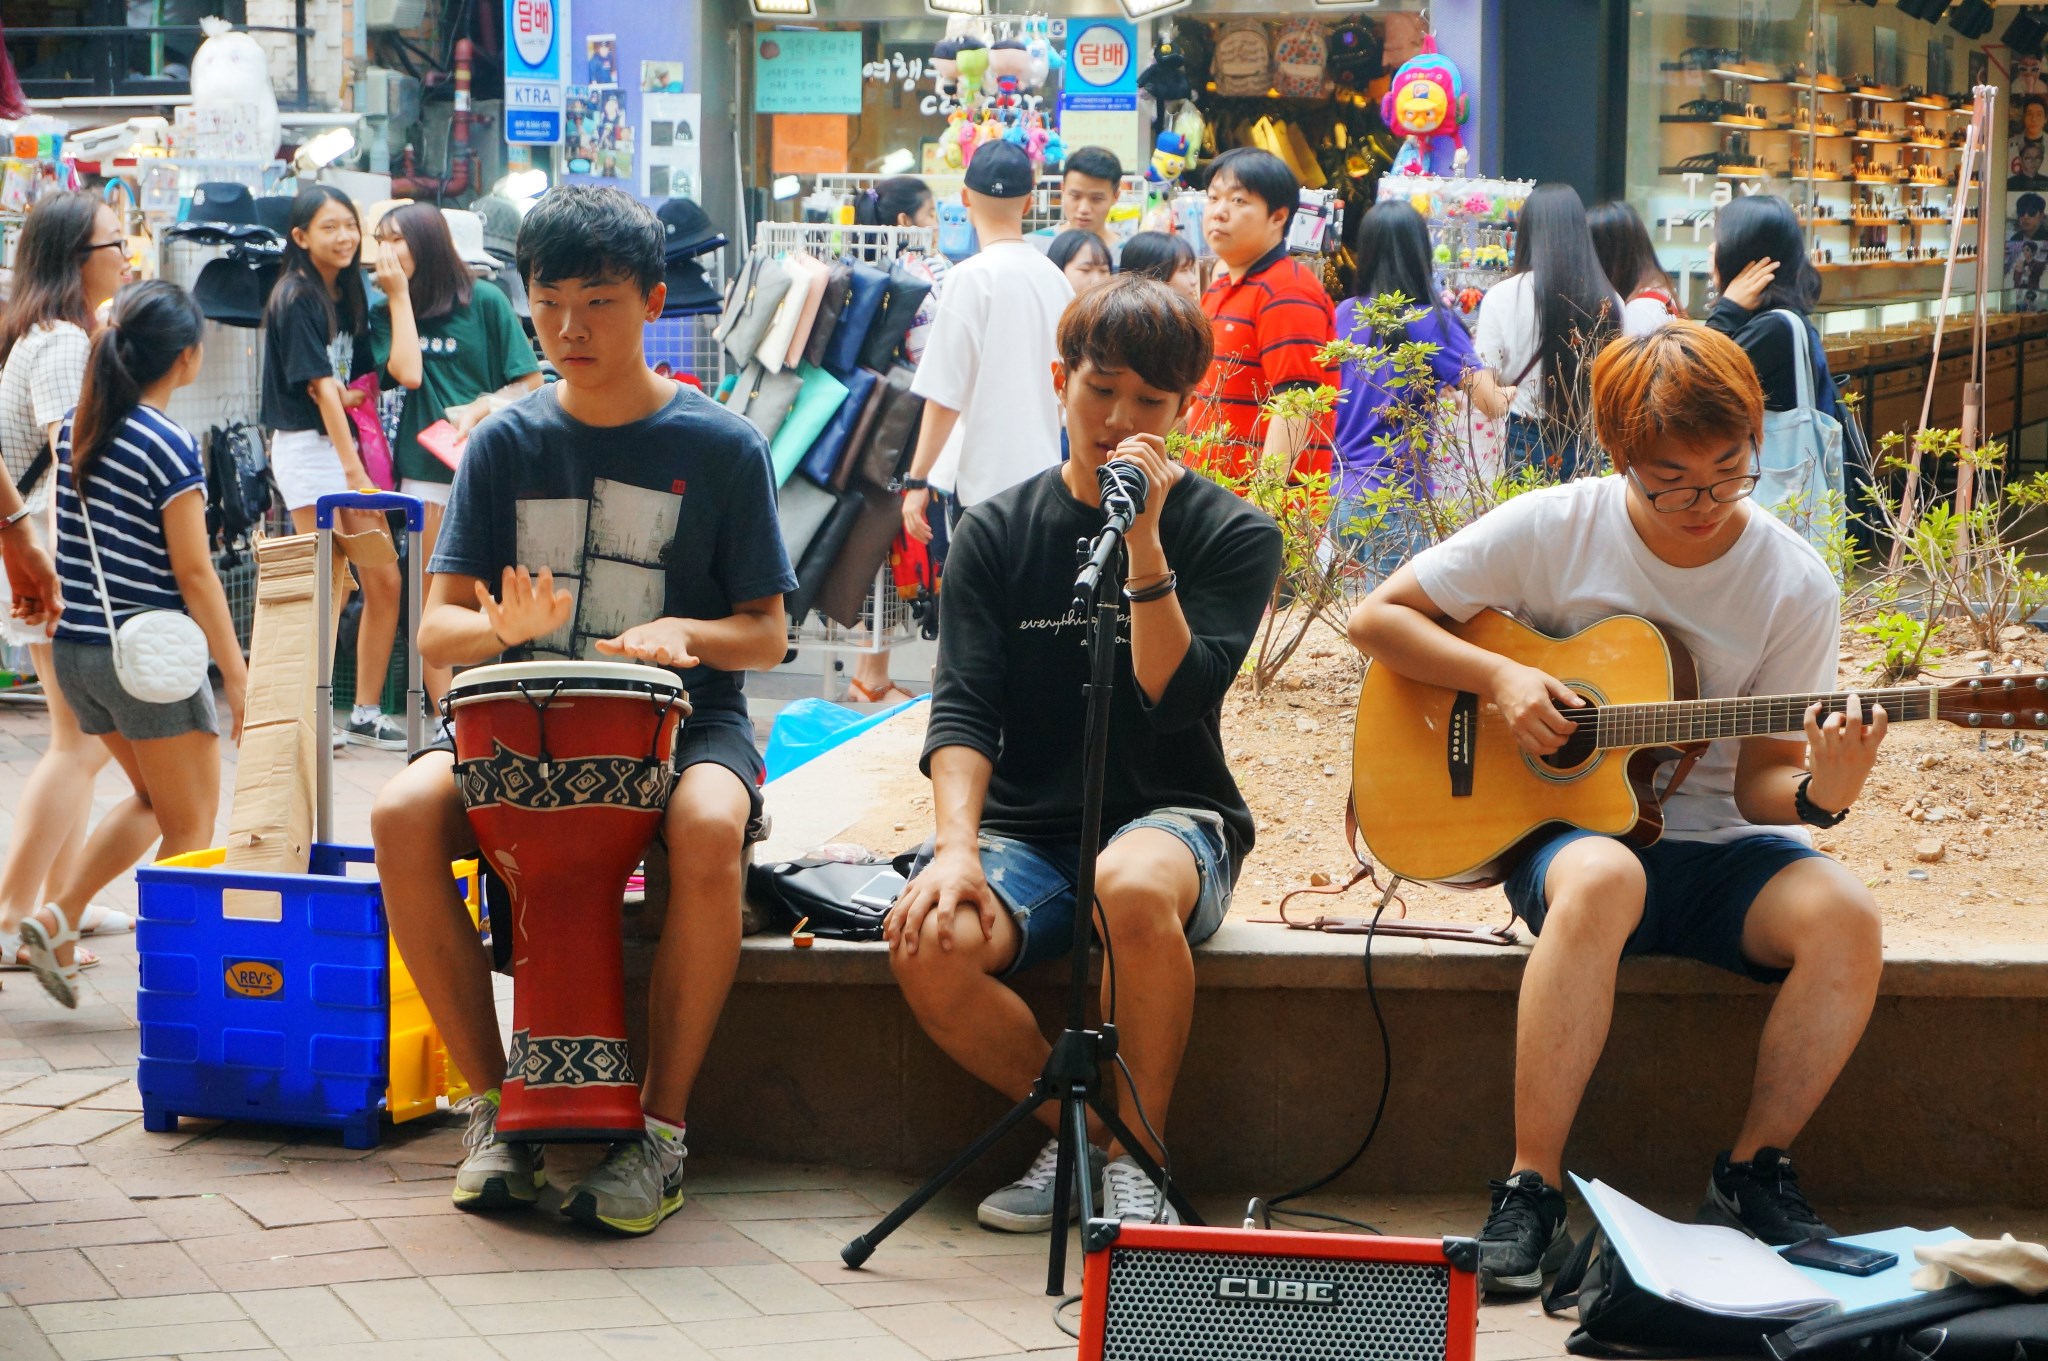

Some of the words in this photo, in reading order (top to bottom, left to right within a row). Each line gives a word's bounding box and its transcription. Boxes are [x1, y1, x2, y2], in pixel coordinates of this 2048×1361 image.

[519, 0, 549, 34] 담배
[1080, 43, 1124, 66] 담배
[515, 86, 552, 104] KTRA
[1219, 1277, 1333, 1302] CUBE
